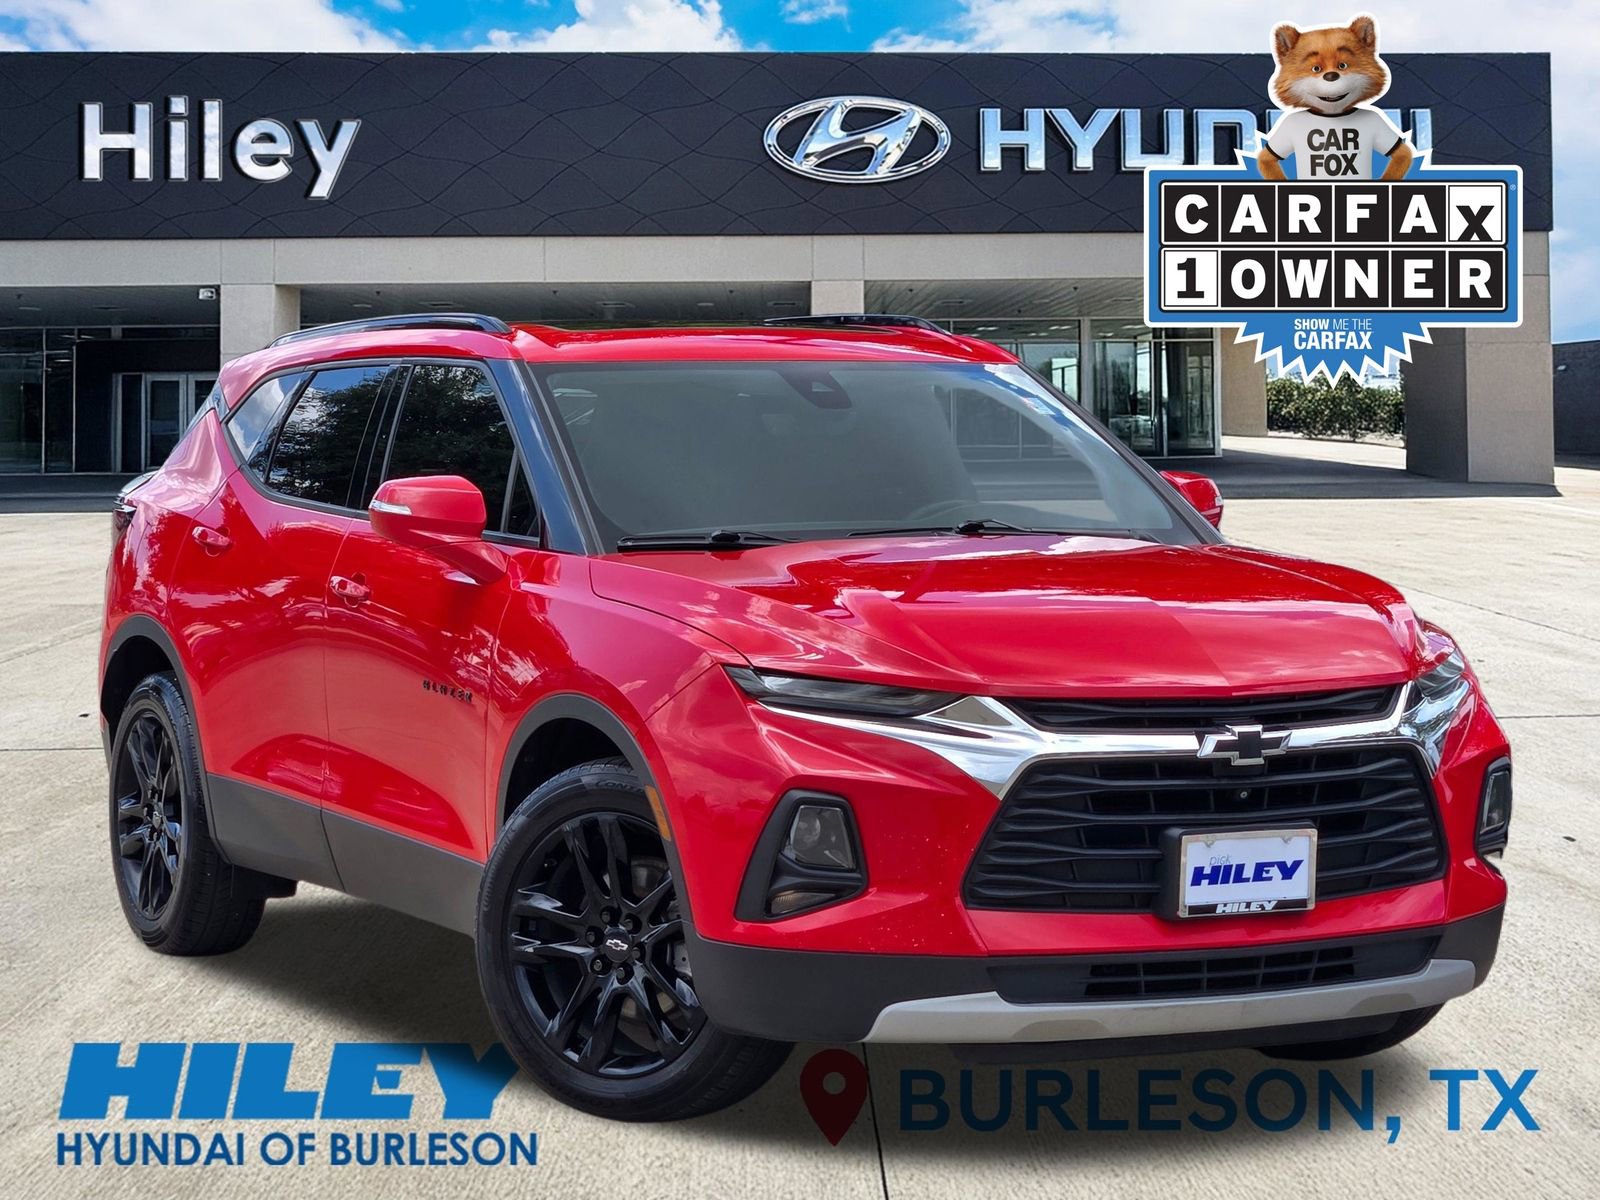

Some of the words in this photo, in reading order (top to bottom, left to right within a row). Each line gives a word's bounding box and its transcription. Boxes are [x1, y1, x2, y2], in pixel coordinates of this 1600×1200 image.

[80, 95, 361, 199] Hiley
[979, 107, 1433, 171] HYUNI
[1191, 860, 1303, 886] HILEY
[1216, 901, 1278, 914] HILEY
